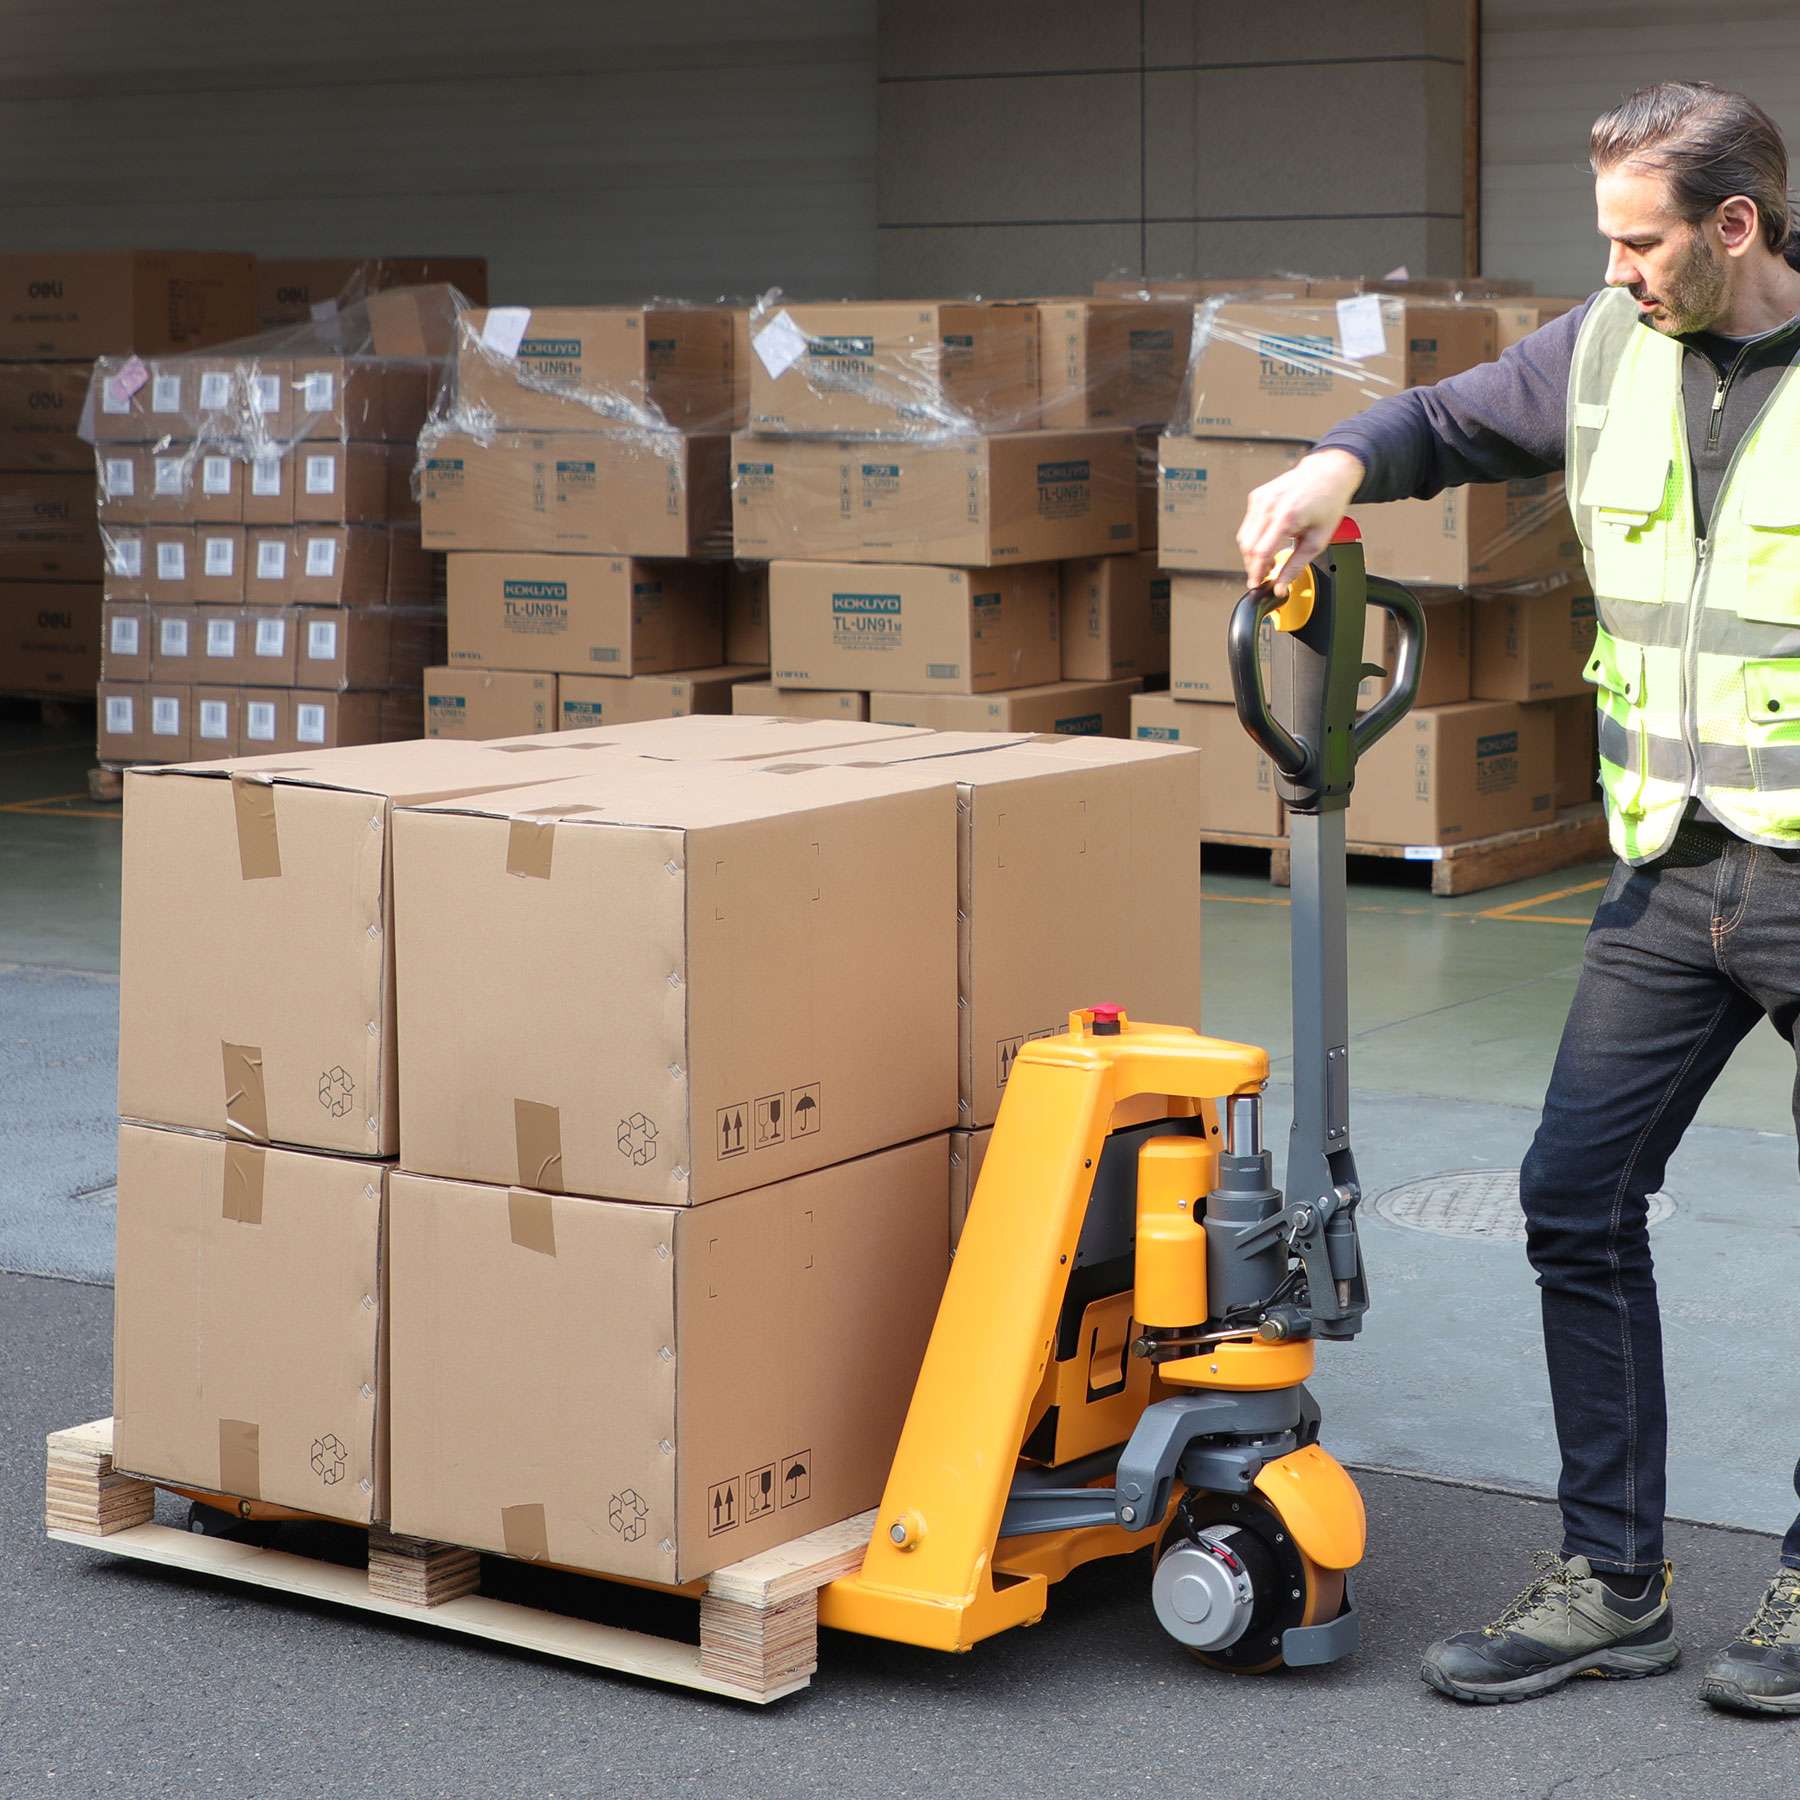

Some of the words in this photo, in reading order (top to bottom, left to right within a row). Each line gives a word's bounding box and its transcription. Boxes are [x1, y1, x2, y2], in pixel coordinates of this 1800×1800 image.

[519, 343, 580, 354] KOKUYO
[505, 585, 565, 596] KOKUYO
[834, 598, 899, 610] KOKUYO
